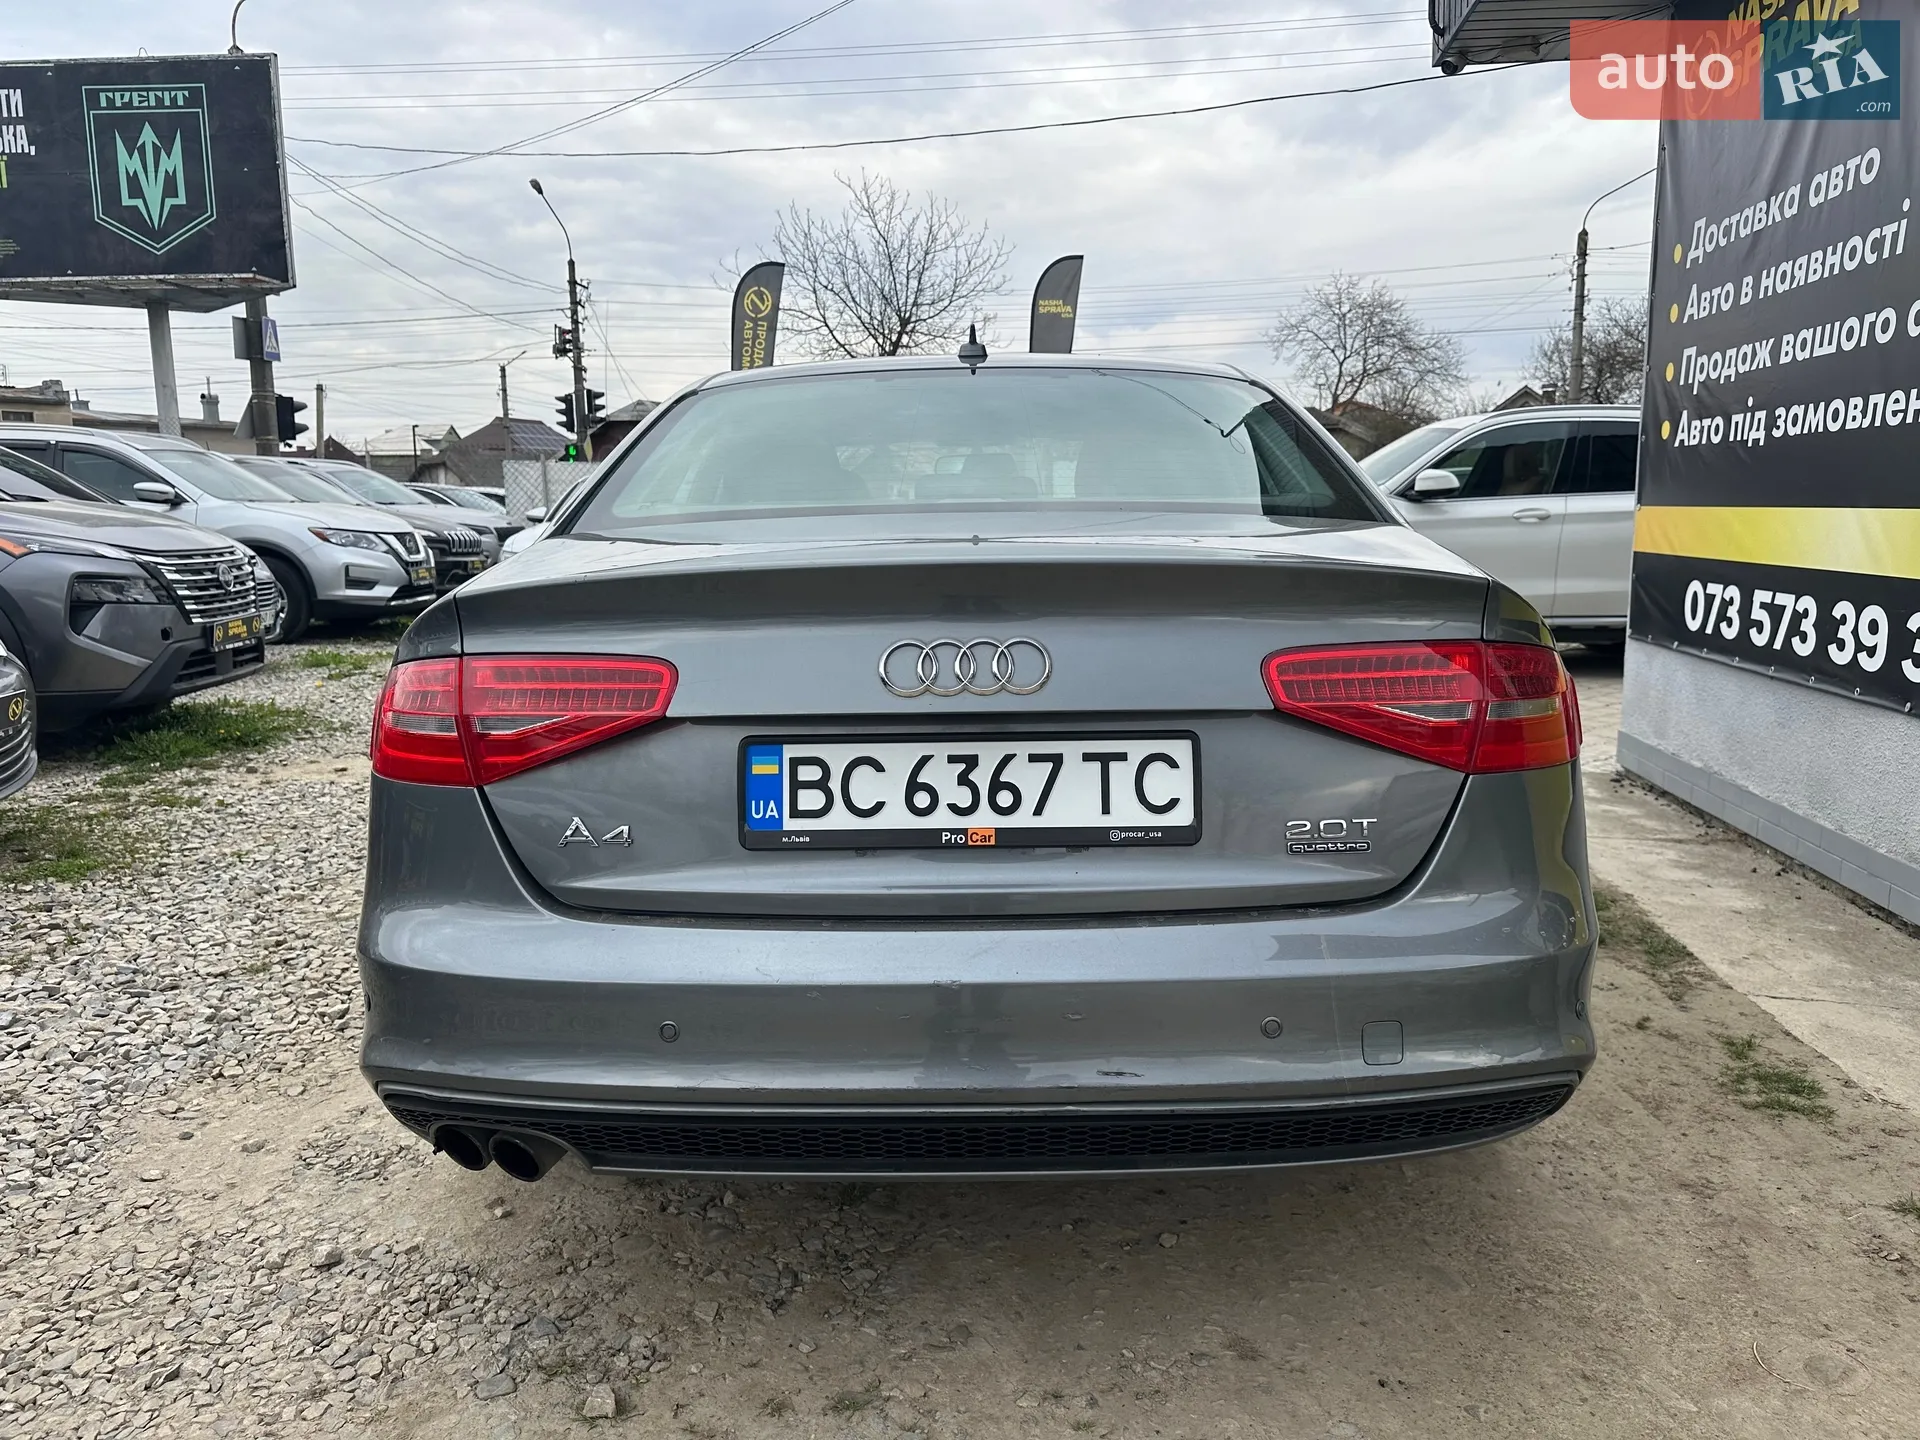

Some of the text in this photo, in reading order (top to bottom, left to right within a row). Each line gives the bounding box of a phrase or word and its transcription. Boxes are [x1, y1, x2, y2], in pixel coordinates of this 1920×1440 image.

[1686, 147, 1881, 269] Доставка авто
[1683, 198, 1911, 324] Авто в наявності
[1038, 305, 1073, 314] SPRAVA
[742, 320, 754, 370] АВТОМ
[753, 321, 767, 368] ПРОДА
[1679, 337, 1775, 396] Продаж
[1779, 307, 1897, 364] вашого
[1674, 410, 1724, 448] Авто
[1728, 395, 1767, 447] під
[1684, 579, 1741, 640] 073
[1749, 589, 1818, 657] 573
[1827, 600, 1889, 673] 39
[751, 800, 779, 819] UA
[788, 752, 1181, 819] BC 6367 TC
[558, 816, 633, 847] A4
[1292, 842, 1369, 853] quattro
